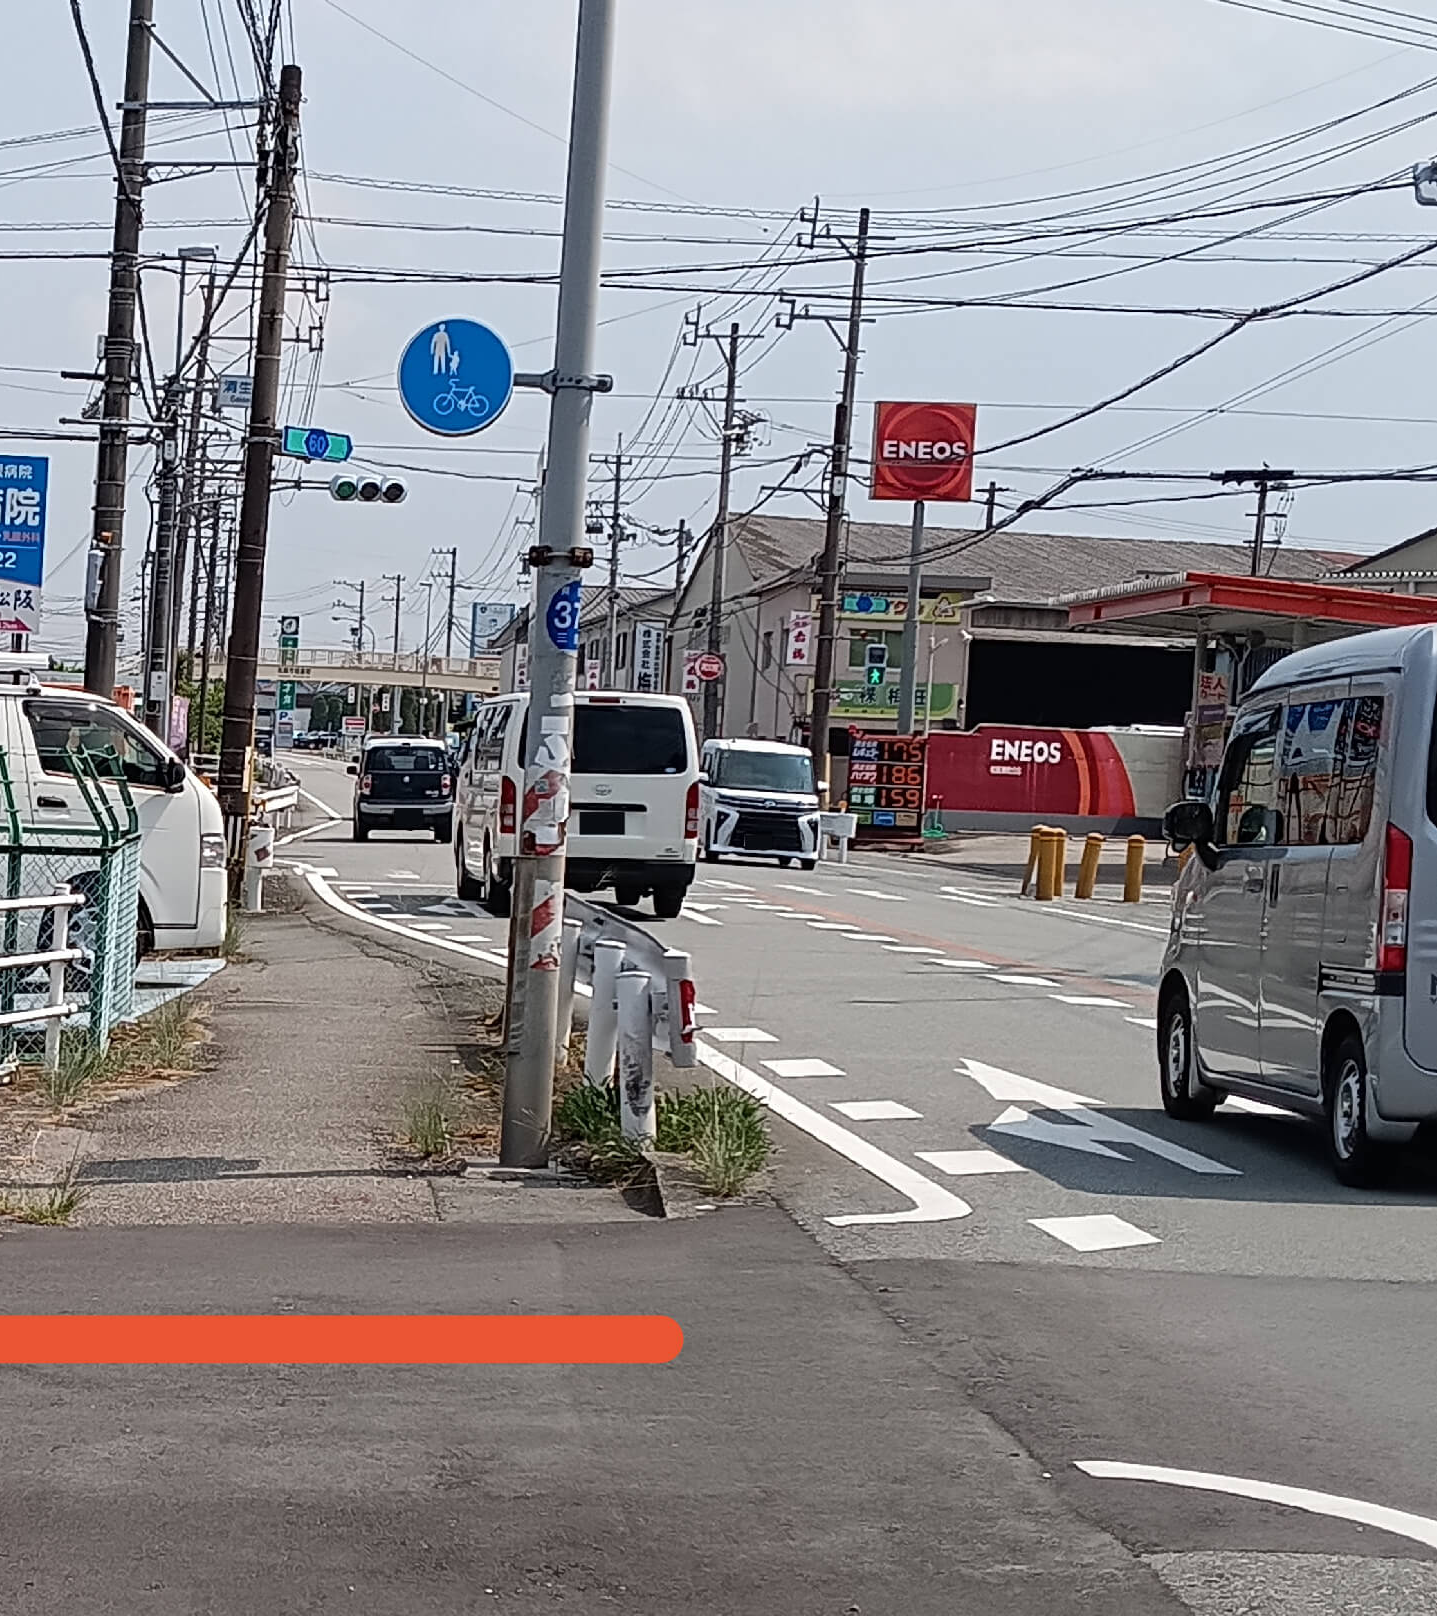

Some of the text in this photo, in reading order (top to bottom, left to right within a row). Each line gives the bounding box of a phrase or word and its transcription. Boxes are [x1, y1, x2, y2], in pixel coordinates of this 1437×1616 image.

[309, 434, 326, 454] 60
[883, 439, 967, 461] ENEOS
[884, 742, 922, 762] 175
[990, 738, 1062, 764] ENEOS
[882, 765, 921, 785] 186
[881, 789, 920, 808] 159
